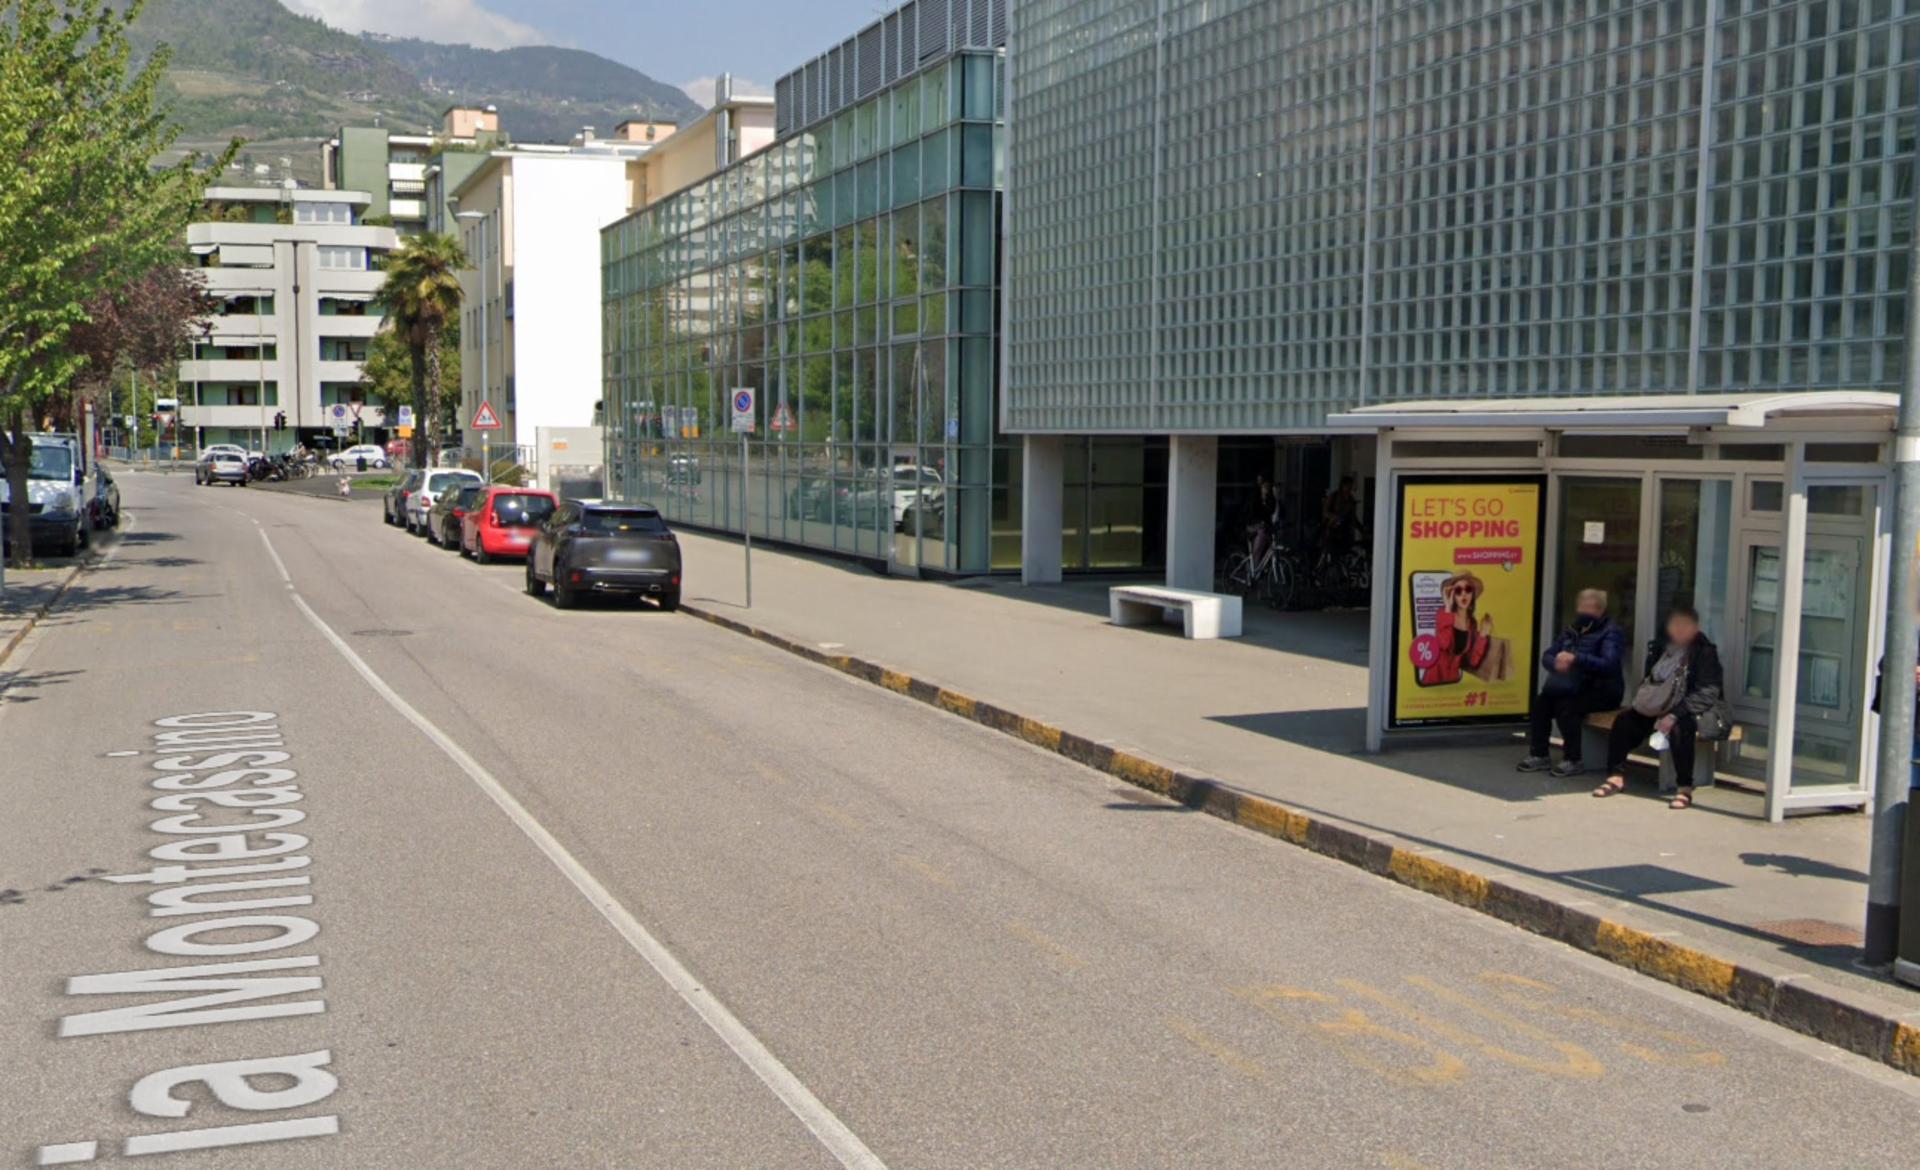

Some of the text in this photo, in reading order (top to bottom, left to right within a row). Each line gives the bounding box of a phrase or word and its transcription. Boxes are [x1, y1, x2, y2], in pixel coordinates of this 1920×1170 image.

[1411, 498, 1504, 517] LET'S GO
[1410, 520, 1520, 538] SHOPPING
[1464, 691, 1488, 707] #1
[59, 710, 326, 1038] Montecassino
[1230, 971, 1728, 1088] BUS
